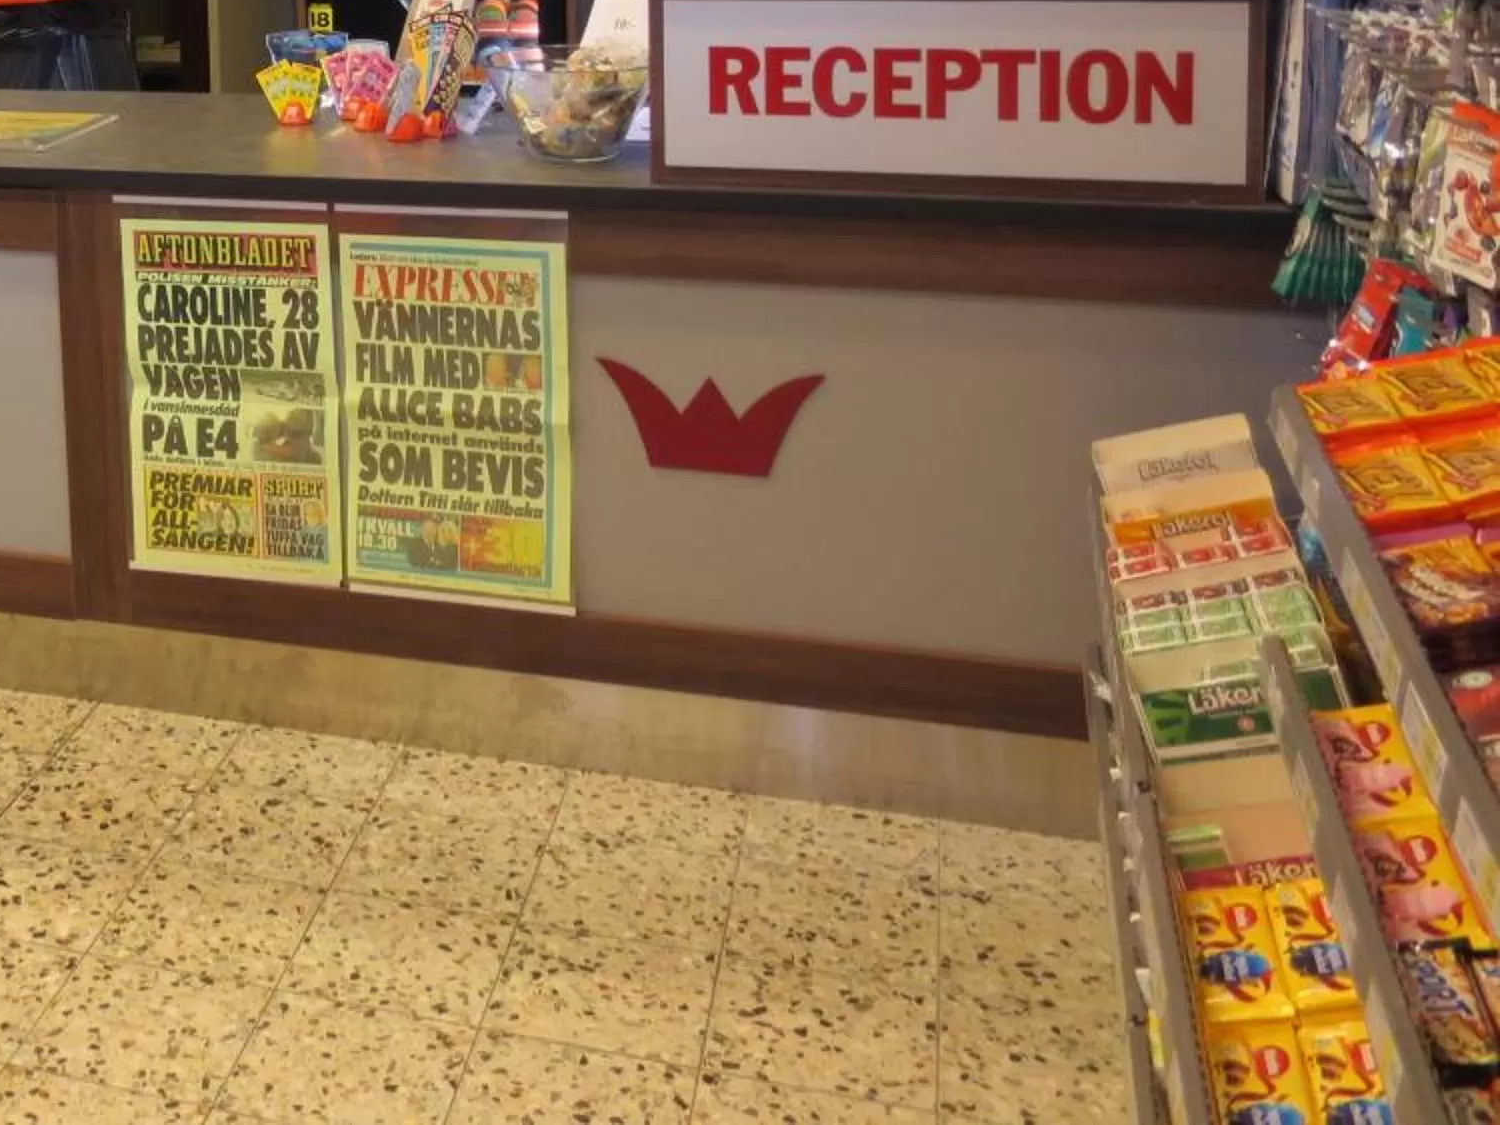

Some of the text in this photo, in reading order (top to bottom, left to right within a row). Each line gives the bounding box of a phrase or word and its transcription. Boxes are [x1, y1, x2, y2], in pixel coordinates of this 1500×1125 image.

[310, 11, 331, 28] 18
[708, 44, 1195, 126] RECEPTION
[137, 233, 312, 269] AFTONBLADET
[137, 284, 320, 330] CAROLINE, 28
[353, 299, 541, 351] VÄNNERNAS
[137, 325, 320, 371] PREJADES AV
[355, 342, 481, 390] FILM MED
[151, 400, 240, 417] vansinnesdåd
[357, 387, 543, 436] ALICE BABS
[143, 413, 239, 460] PÅ E4
[357, 426, 545, 455] på internet används
[358, 440, 545, 500] SOM BEVIS
[153, 510, 198, 530] ALL-
[357, 484, 545, 520] Dottern Titti slår tillbaka
[1187, 682, 1264, 716] Läker
